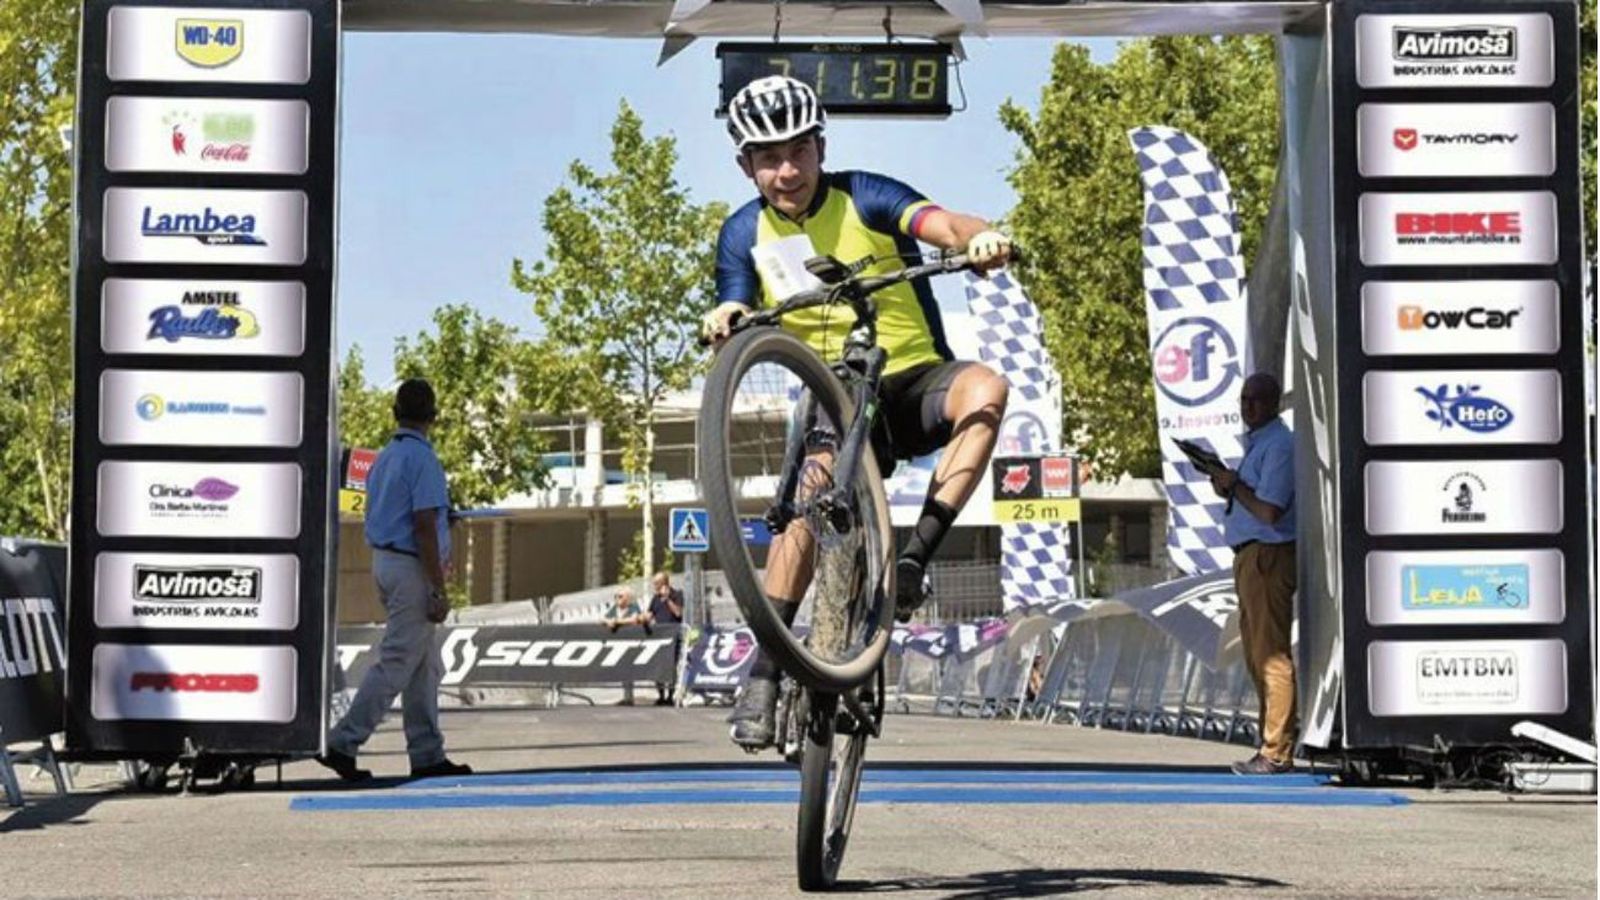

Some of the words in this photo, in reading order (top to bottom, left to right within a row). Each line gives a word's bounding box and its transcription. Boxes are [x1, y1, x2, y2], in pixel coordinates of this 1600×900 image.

[183, 26, 237, 46] WD-40
[1399, 33, 1509, 56] Avimosa
[1393, 65, 1460, 76] INDUSTRIAS
[1421, 133, 1519, 145] TAYMORY
[141, 206, 255, 233] Lambea
[1396, 213, 1521, 235] BIKE
[181, 291, 242, 305] AMSTEL
[1397, 305, 1520, 331] TowCar
[1458, 405, 1508, 422] Hero
[1012, 503, 1036, 520] 25
[1041, 505, 1059, 519] m
[138, 572, 254, 597] Avimosa
[132, 605, 200, 618] INDUSTRIAS
[477, 638, 674, 667] SCOTT
[1421, 656, 1514, 677] EMTBM
